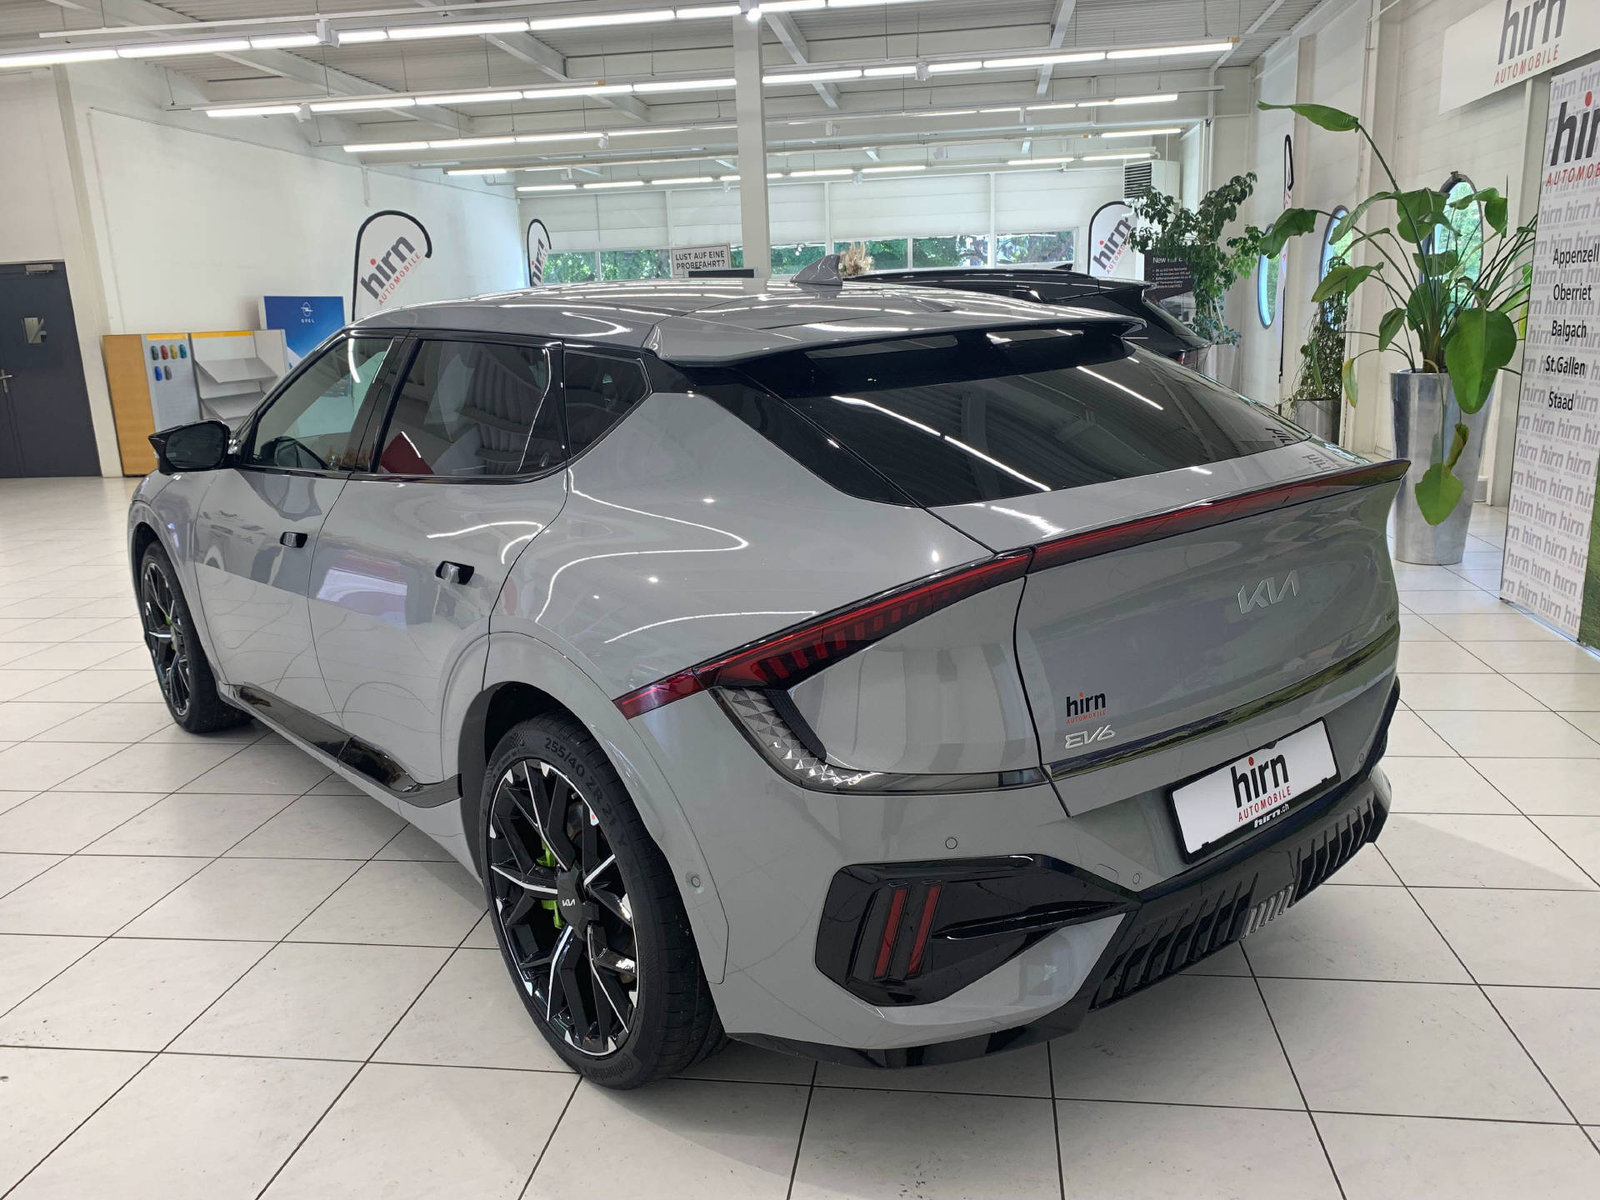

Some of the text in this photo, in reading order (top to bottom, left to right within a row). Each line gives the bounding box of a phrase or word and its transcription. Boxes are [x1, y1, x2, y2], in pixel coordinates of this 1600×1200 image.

[1498, 0, 1566, 65] hirn
[1494, 43, 1559, 86] AUTOMOBILE
[675, 250, 725, 261] LUST AUF EINE
[1093, 217, 1131, 270] hirn
[1152, 256, 1167, 264] New
[1552, 243, 1600, 269] Appenzell
[361, 236, 415, 300] hirn
[378, 251, 422, 306] AUTOMOBILE
[1553, 283, 1592, 301] Oberriet
[1551, 320, 1587, 342] Balgach
[1545, 355, 1586, 376] St.Gallen
[1548, 391, 1575, 411] Staad
[1532, 413, 1555, 435] hirn
[1557, 417, 1581, 442] hirn
[1516, 438, 1539, 461] hirn
[1540, 444, 1564, 468] hirn
[1565, 450, 1592, 475] hirn
[1525, 469, 1547, 493] hirn
[1549, 477, 1573, 502] hirn
[1511, 493, 1533, 518] hirn
[1535, 502, 1557, 526] hirn
[1559, 510, 1584, 537] hirn
[1521, 524, 1542, 551] hirn
[1543, 534, 1567, 561] hirn
[1505, 548, 1529, 573] hirn
[1530, 557, 1551, 584] hirn
[1553, 568, 1577, 597] hirn
[1237, 569, 1300, 615] KIA
[1517, 580, 1538, 606] hirn
[1539, 590, 1562, 619] hirn
[1066, 691, 1106, 717] hirn
[1065, 724, 1116, 749] EV6
[544, 737, 585, 778] 255/40
[1230, 754, 1289, 808] hirn
[1238, 785, 1291, 822] AUTOMOBILE
